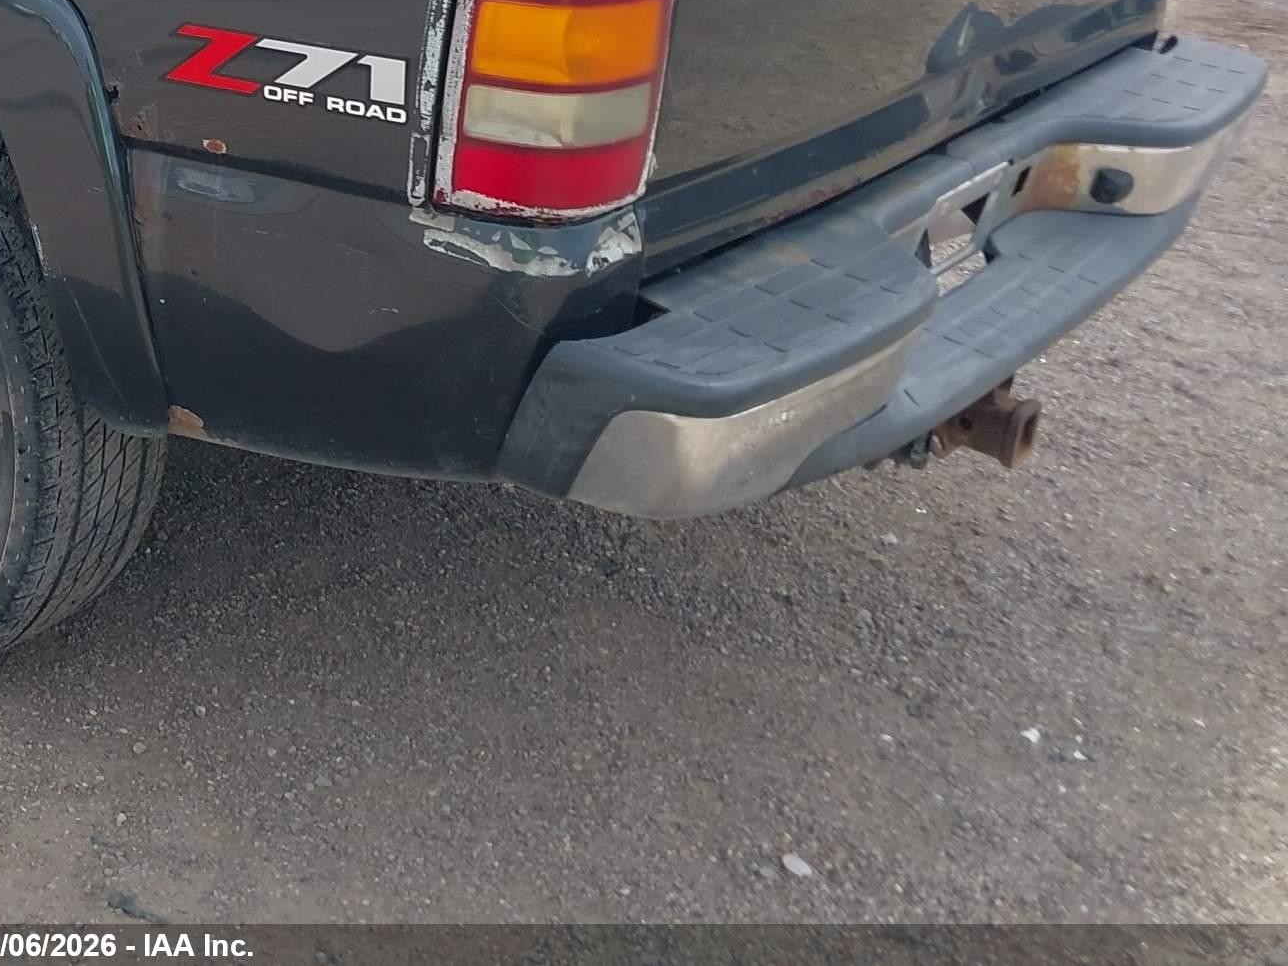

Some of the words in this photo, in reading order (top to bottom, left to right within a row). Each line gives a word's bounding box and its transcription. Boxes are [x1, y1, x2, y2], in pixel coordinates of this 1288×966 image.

[166, 24, 407, 105] Z71
[263, 85, 315, 106] OFF
[326, 97, 407, 124] ROAD
